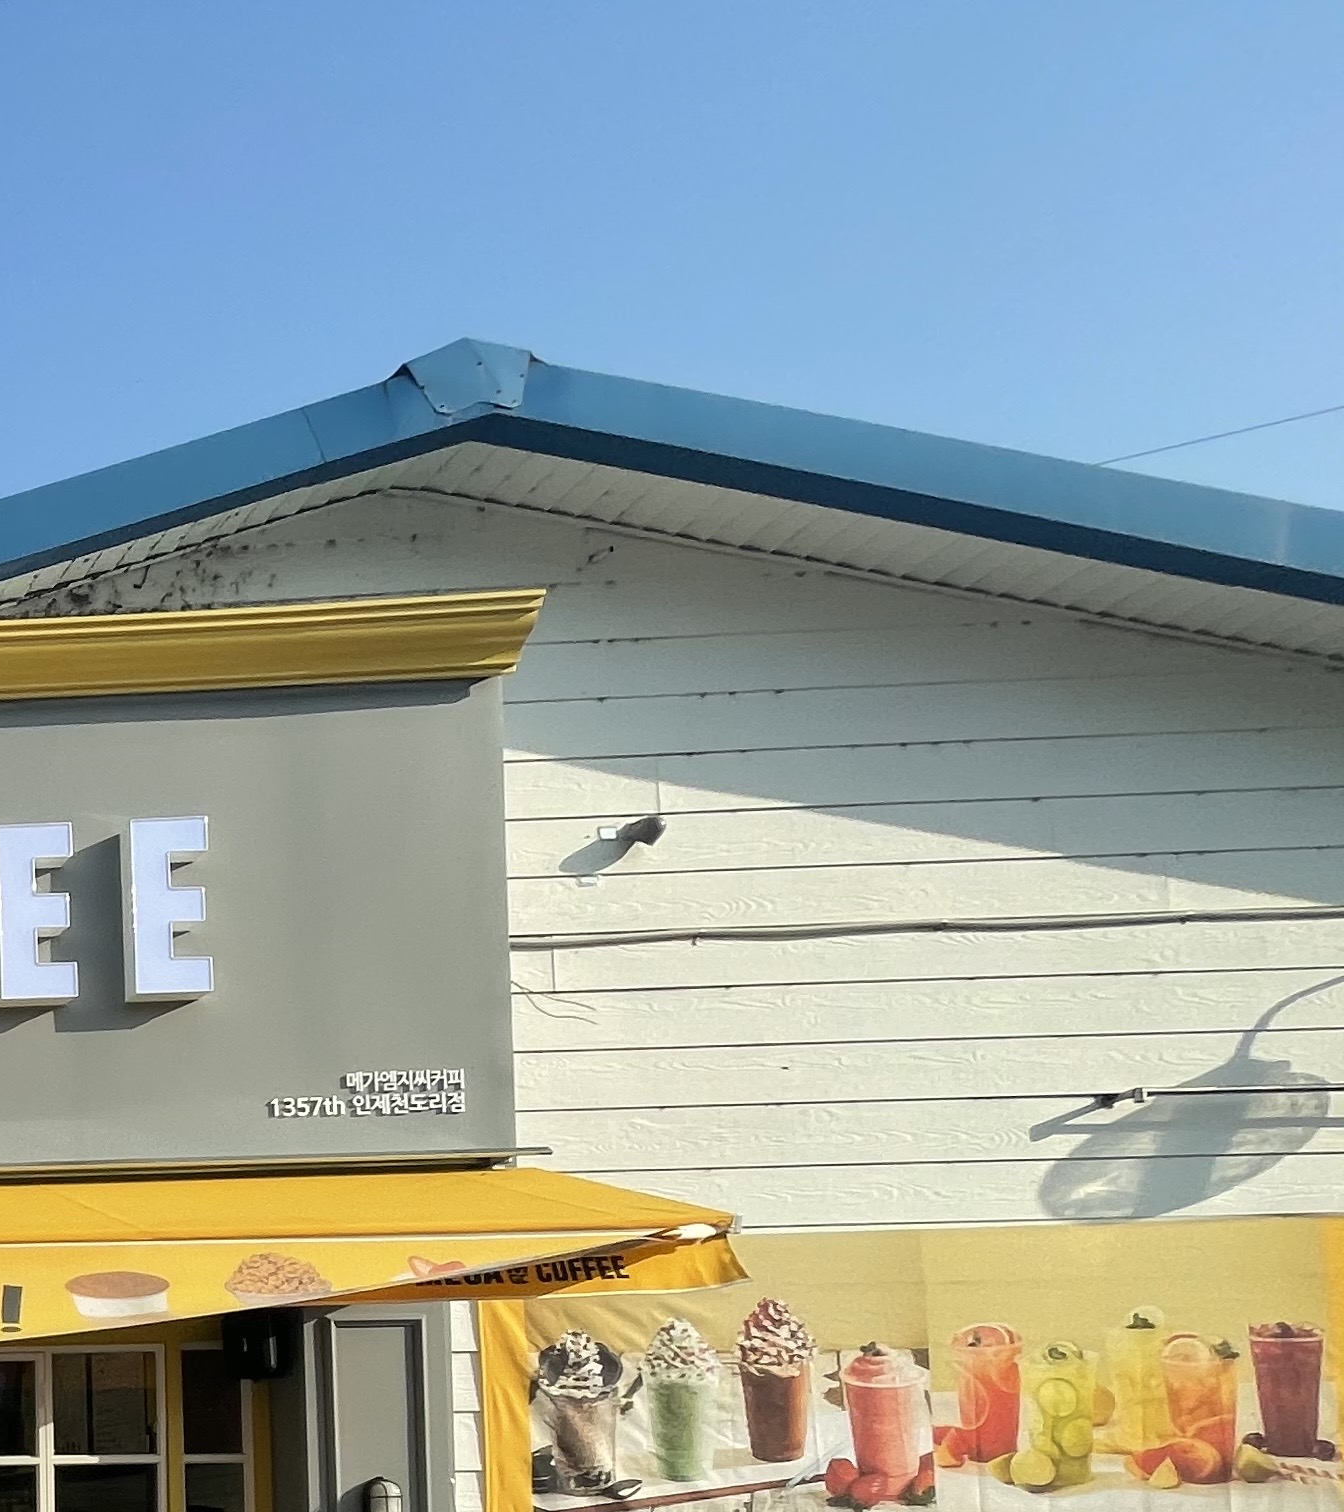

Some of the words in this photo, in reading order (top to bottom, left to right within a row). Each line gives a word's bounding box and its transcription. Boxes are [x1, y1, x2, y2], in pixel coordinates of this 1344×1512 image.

[346, 1068, 466, 1092] 메가엠지씨커피
[270, 1095, 346, 1117] 1357th
[352, 1092, 467, 1115] 인제천도리점
[535, 1256, 630, 1283] COFFEE
